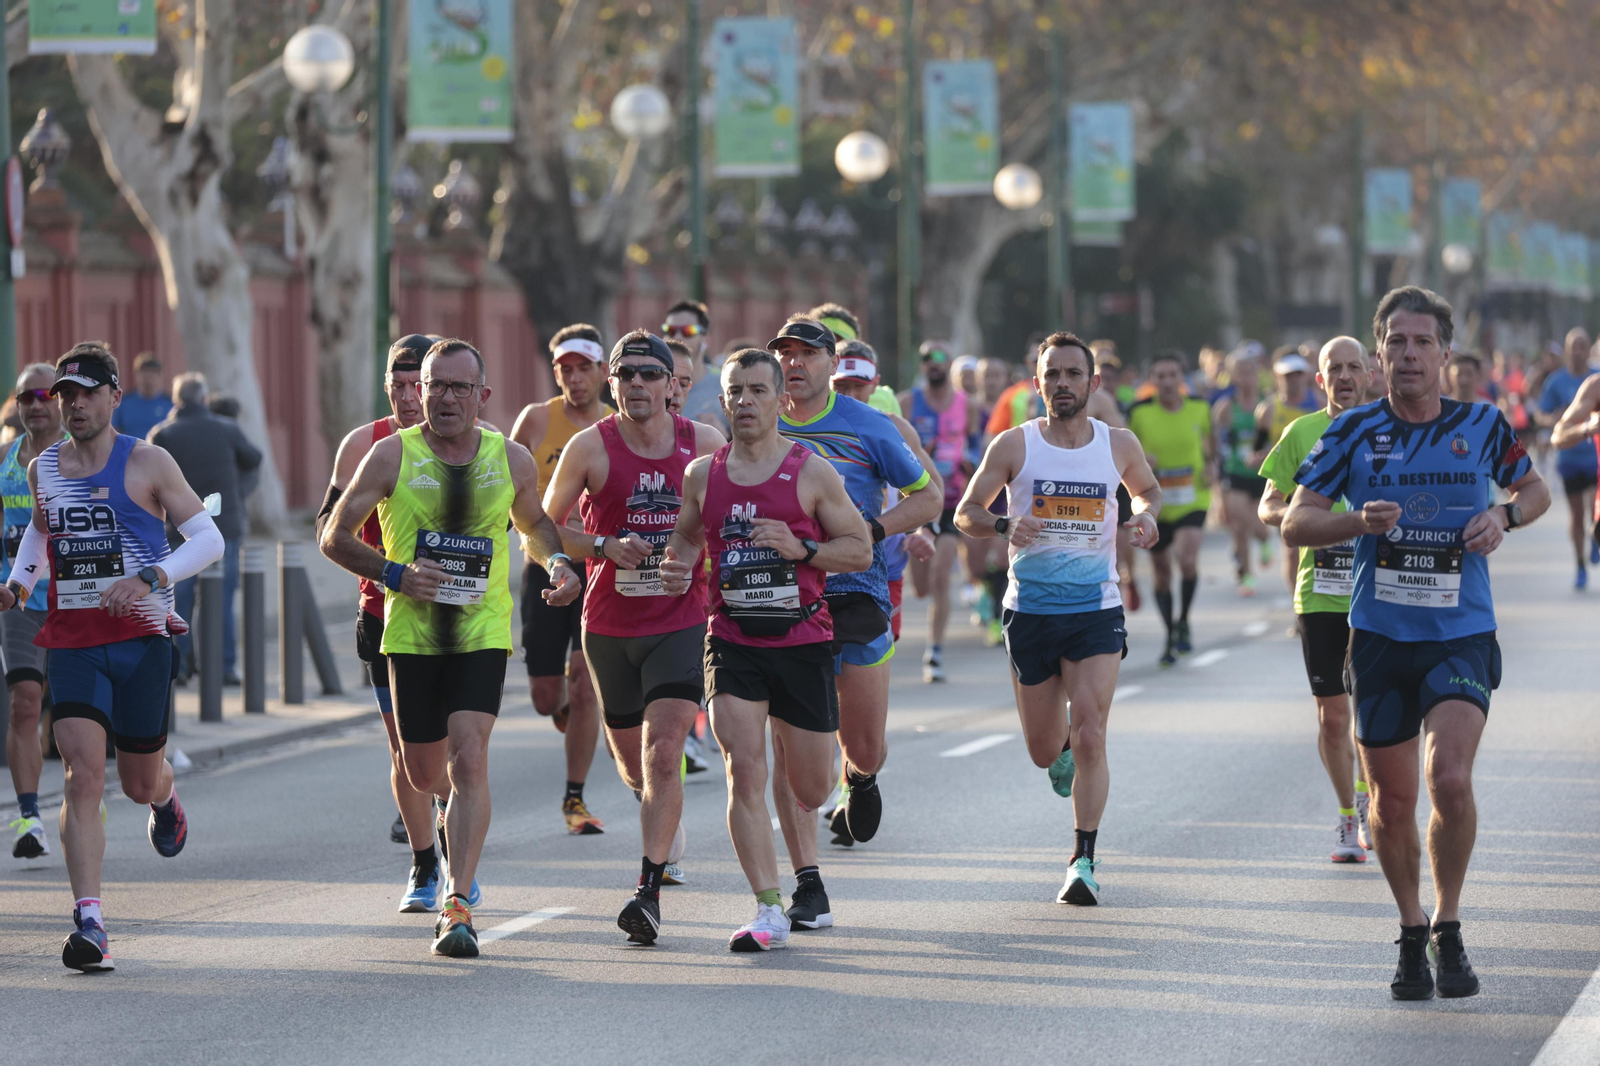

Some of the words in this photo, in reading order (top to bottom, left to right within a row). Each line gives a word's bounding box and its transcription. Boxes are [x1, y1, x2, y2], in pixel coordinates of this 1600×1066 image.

[1368, 474, 1395, 488] C.D.
[1399, 472, 1476, 486] BESTIAJOS
[1058, 485, 1098, 495] ZURICH
[1057, 505, 1080, 516] 5191
[45, 504, 117, 534] USA
[627, 514, 646, 524] LOS
[1044, 521, 1096, 532] UCIAS-PAULA
[644, 534, 669, 544] ZURI
[1406, 530, 1455, 542] ZURICH
[72, 540, 112, 552] ZURICH
[442, 537, 485, 550] ZURICH
[645, 555, 662, 566] 187
[743, 550, 781, 562] ZURIC
[1334, 557, 1352, 567] 218
[1404, 554, 1435, 568] 2103
[74, 563, 97, 575] 2241
[440, 558, 466, 572] 2893
[745, 572, 771, 585] 1860
[1322, 571, 1346, 580] GÓMEZ
[1398, 574, 1438, 586] MANUEL
[79, 581, 96, 591] JAVI
[745, 590, 774, 600] MARIO
